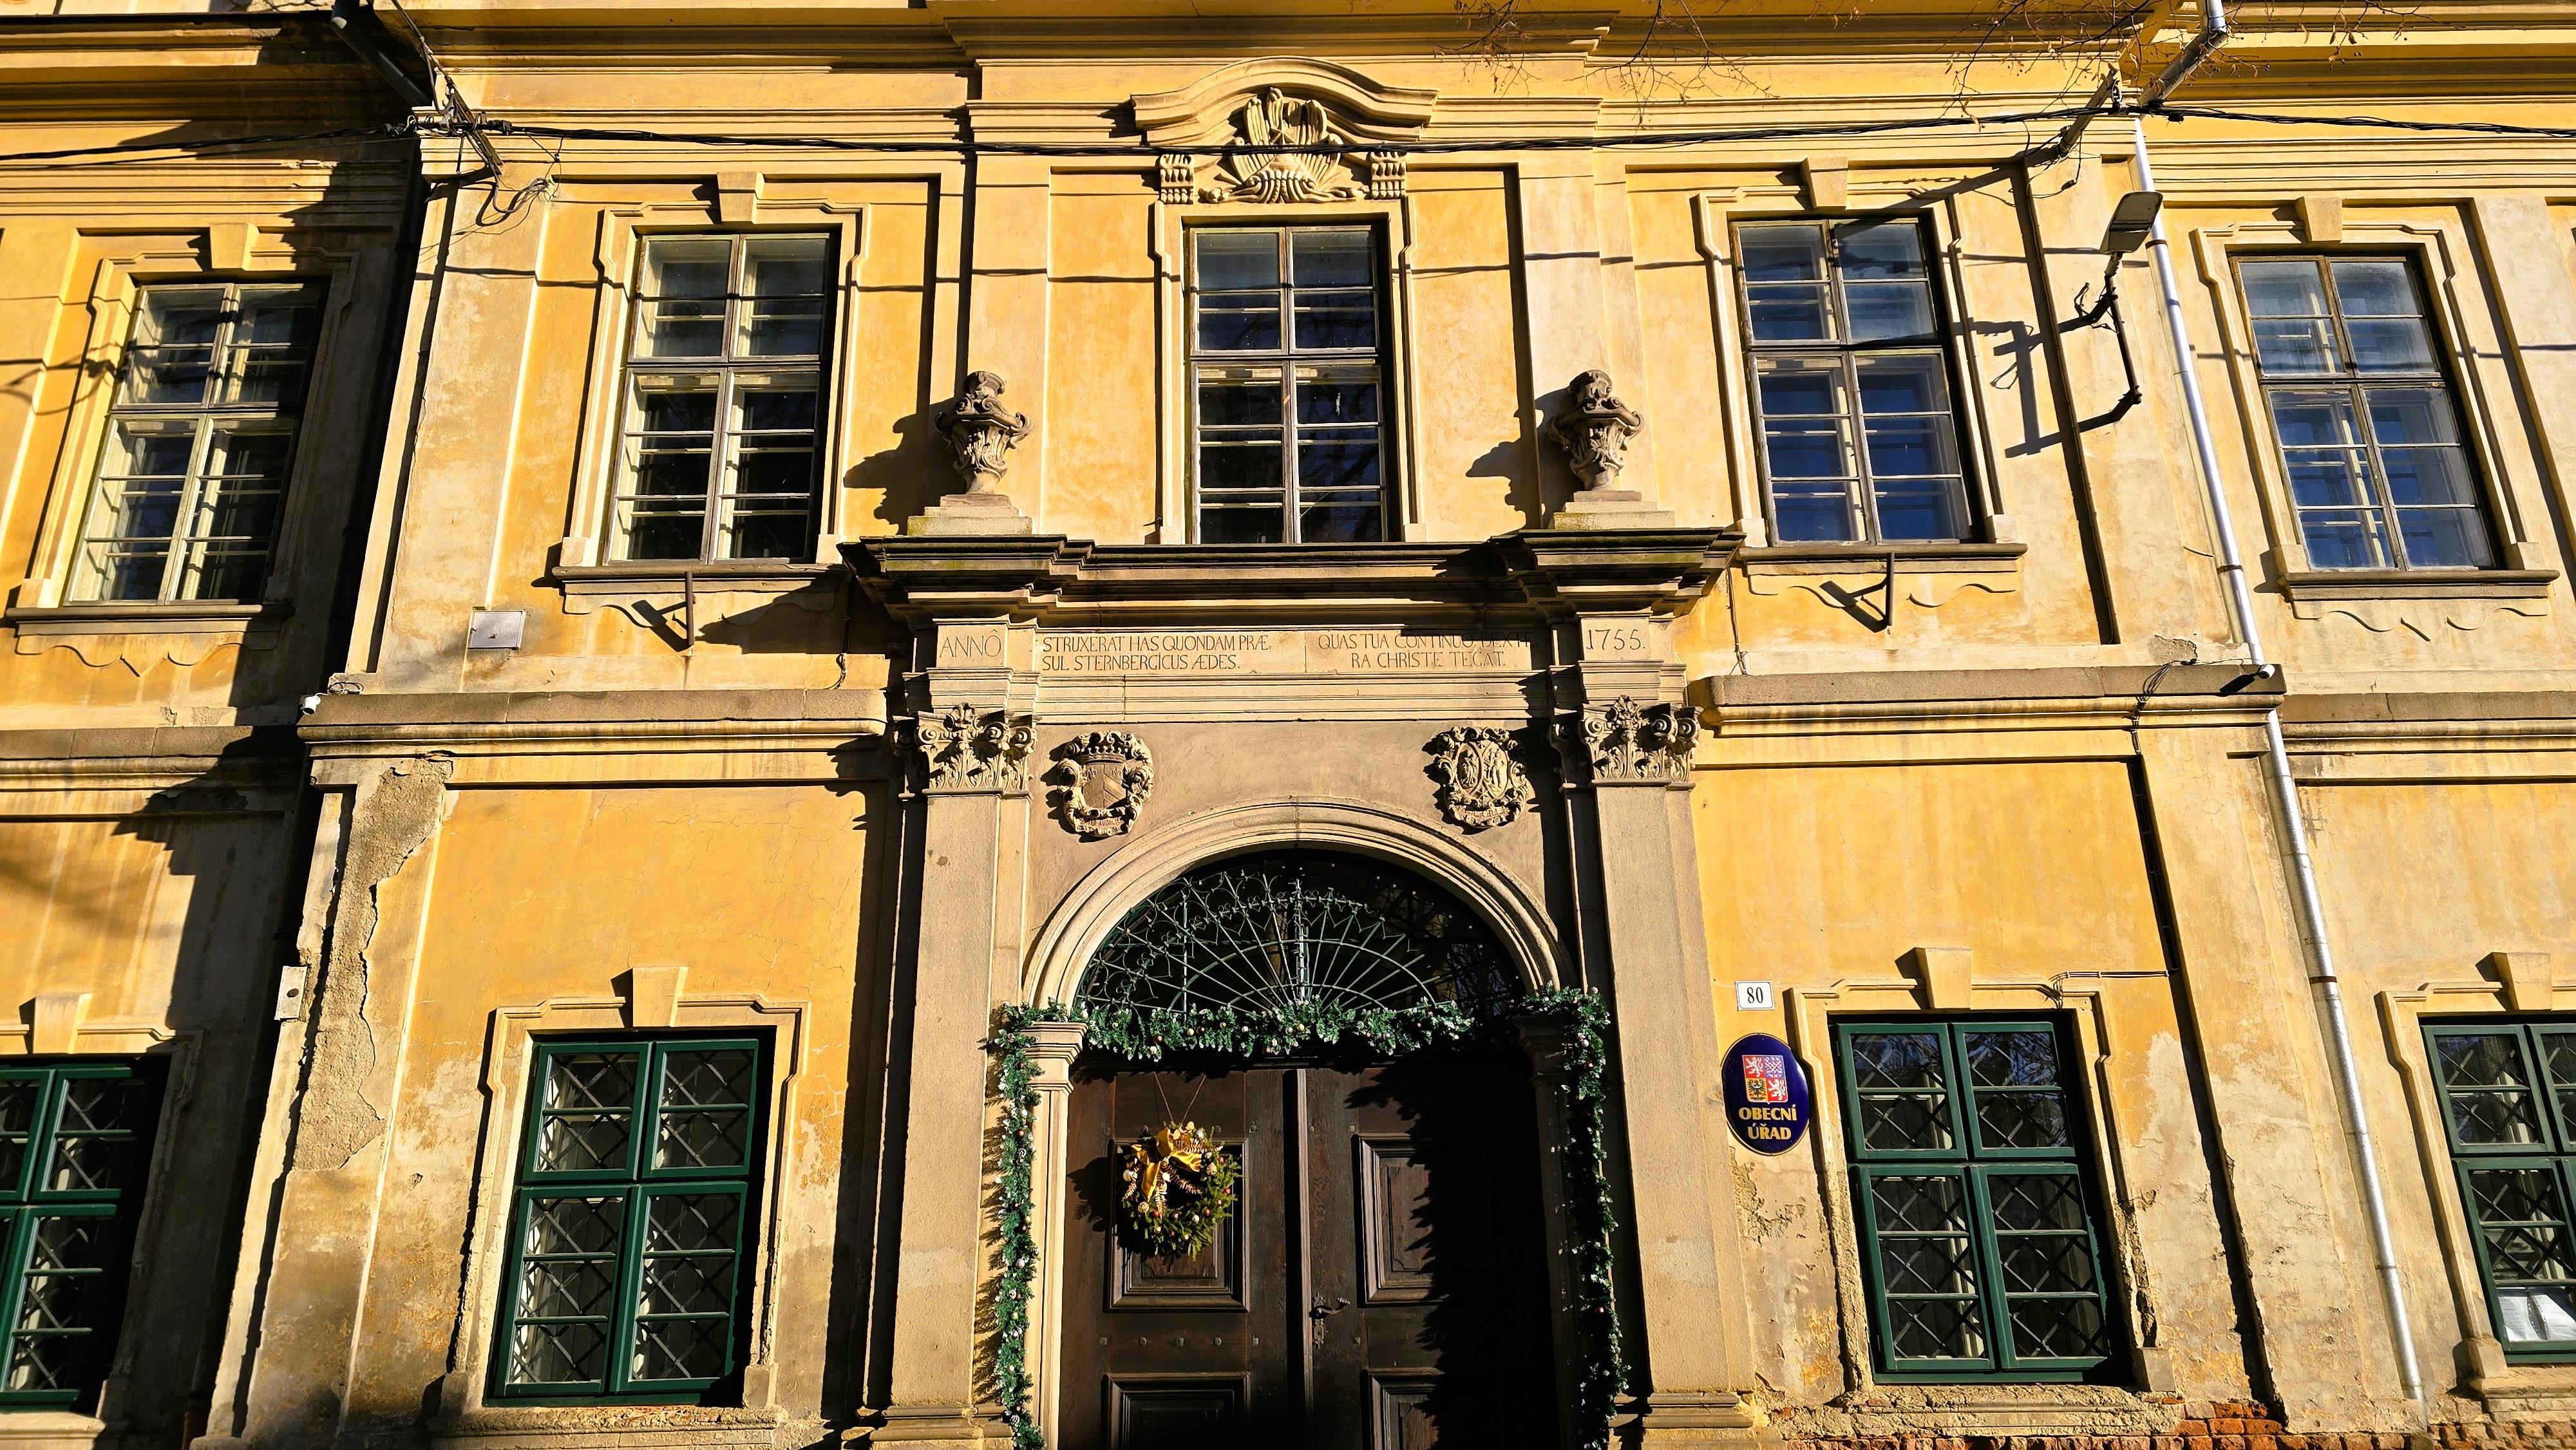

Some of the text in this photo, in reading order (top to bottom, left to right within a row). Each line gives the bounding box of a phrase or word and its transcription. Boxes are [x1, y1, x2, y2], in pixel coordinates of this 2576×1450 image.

[1042, 636, 1125, 652] STRUXERAT
[1130, 636, 1159, 652] HAS
[1162, 635, 1235, 652] QUONDAM
[1318, 634, 1358, 650] QUAS
[1360, 634, 1390, 649] TUA
[1042, 655, 1070, 671] SUL
[1074, 652, 1188, 671] STERNBERGICUS
[1352, 652, 1371, 668] RA
[1377, 650, 1443, 668] CHRISTE
[1747, 986, 1764, 1004] 80
[1738, 1104, 1797, 1121] OBECNÍ
[1747, 1123, 1792, 1140] ÚŘAD
